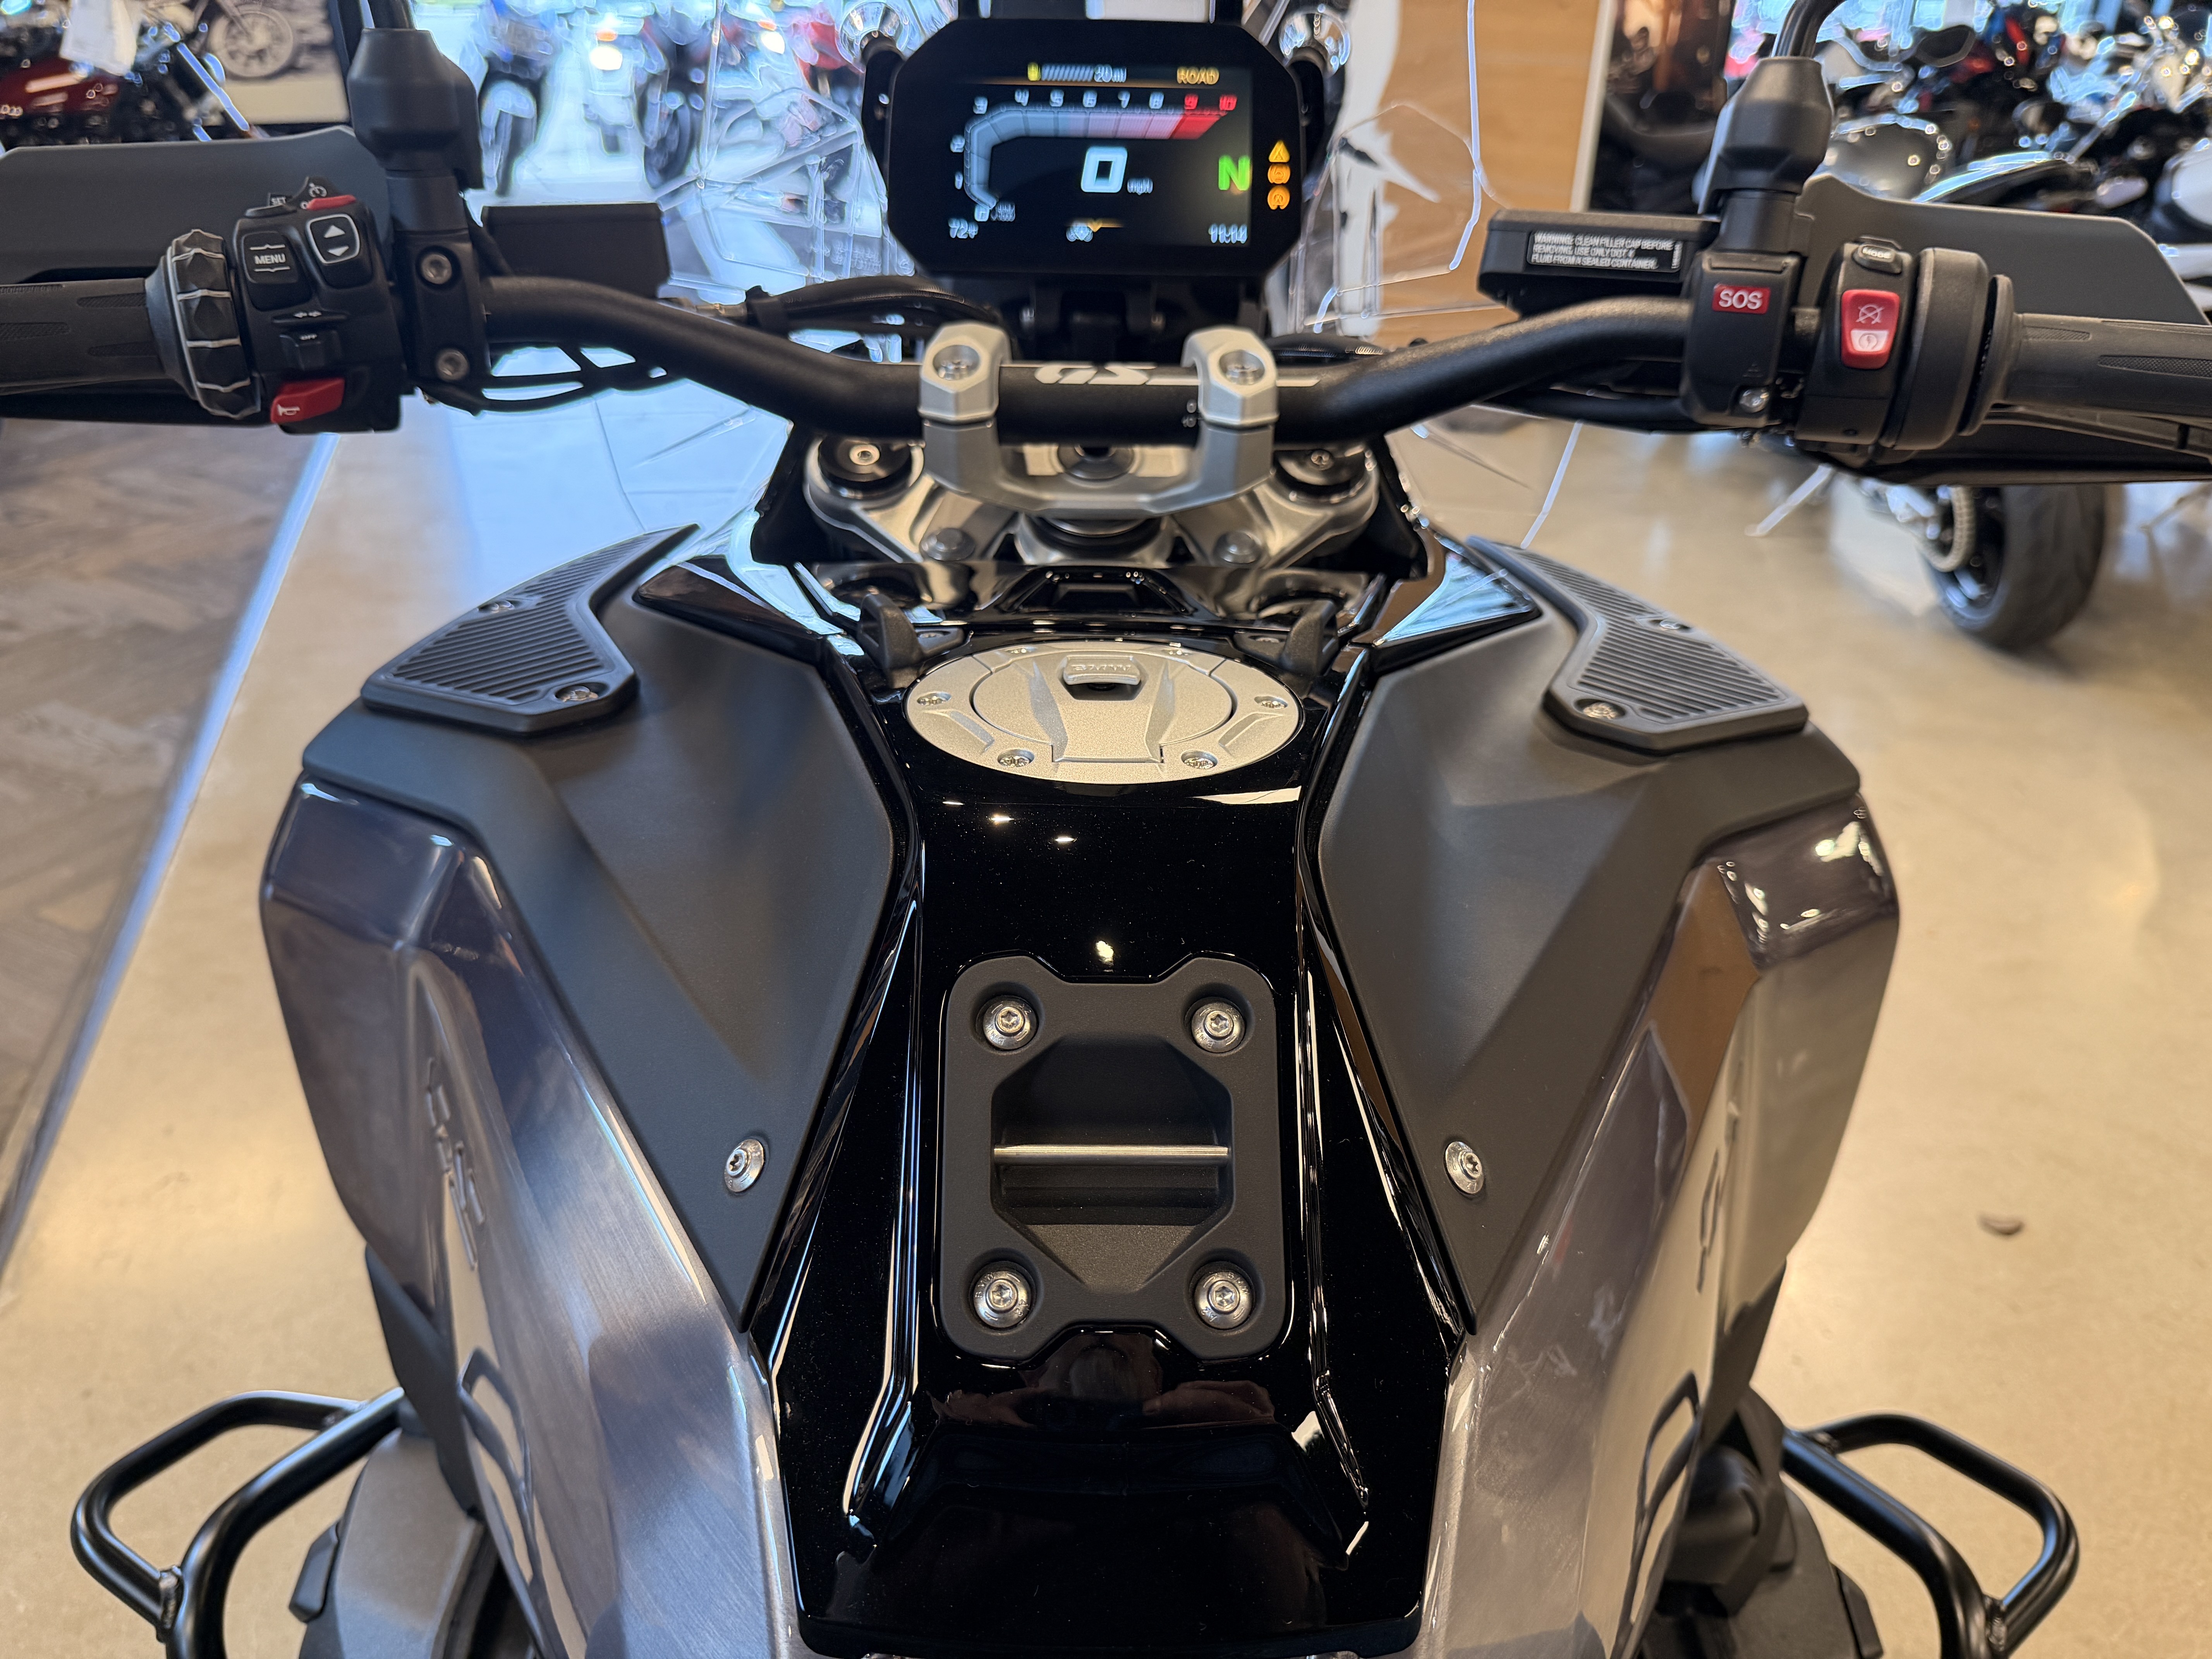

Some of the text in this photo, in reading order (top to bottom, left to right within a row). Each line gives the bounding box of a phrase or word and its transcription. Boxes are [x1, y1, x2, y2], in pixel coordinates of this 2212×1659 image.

[1177, 65, 1219, 84] ROAD
[1049, 89, 1064, 107] 5
[1184, 93, 1199, 110] 9
[1081, 146, 1127, 193] 0
[1218, 155, 1250, 191] N
[271, 196, 286, 205] SET
[1575, 234, 1600, 247] CLEAN
[1600, 235, 1625, 248] FILLER
[1625, 237, 1642, 249] CAP
[1641, 238, 1674, 251] BEFORE
[254, 253, 286, 264] MENU
[1531, 253, 1553, 263] FLUID
[1553, 254, 1576, 264] FROM
[1582, 256, 1611, 267] SEALED
[1574, 246, 1590, 256] USE
[1590, 247, 1610, 257] ONLY
[1862, 247, 1892, 259] MODE
[1719, 290, 1763, 310] SOS
